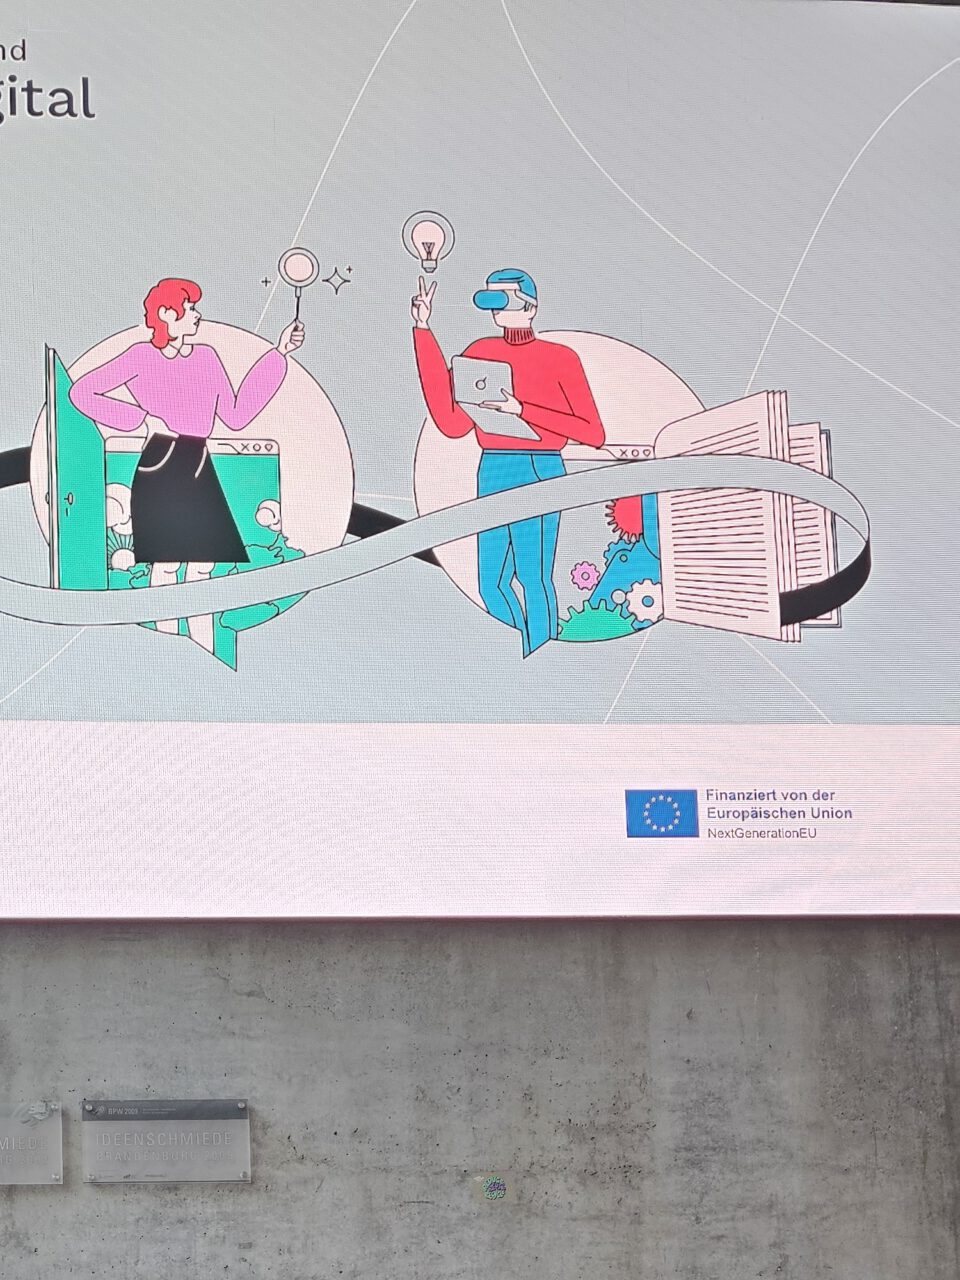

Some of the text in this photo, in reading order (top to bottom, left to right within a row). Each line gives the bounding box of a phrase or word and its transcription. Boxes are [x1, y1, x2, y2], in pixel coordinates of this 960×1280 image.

[706, 788, 835, 801] Finanziert von der
[707, 806, 853, 822] Europäischen Union
[707, 827, 817, 839] NextGenerationEU
[96, 1131, 233, 1146] IDEENSCHMIEDE
